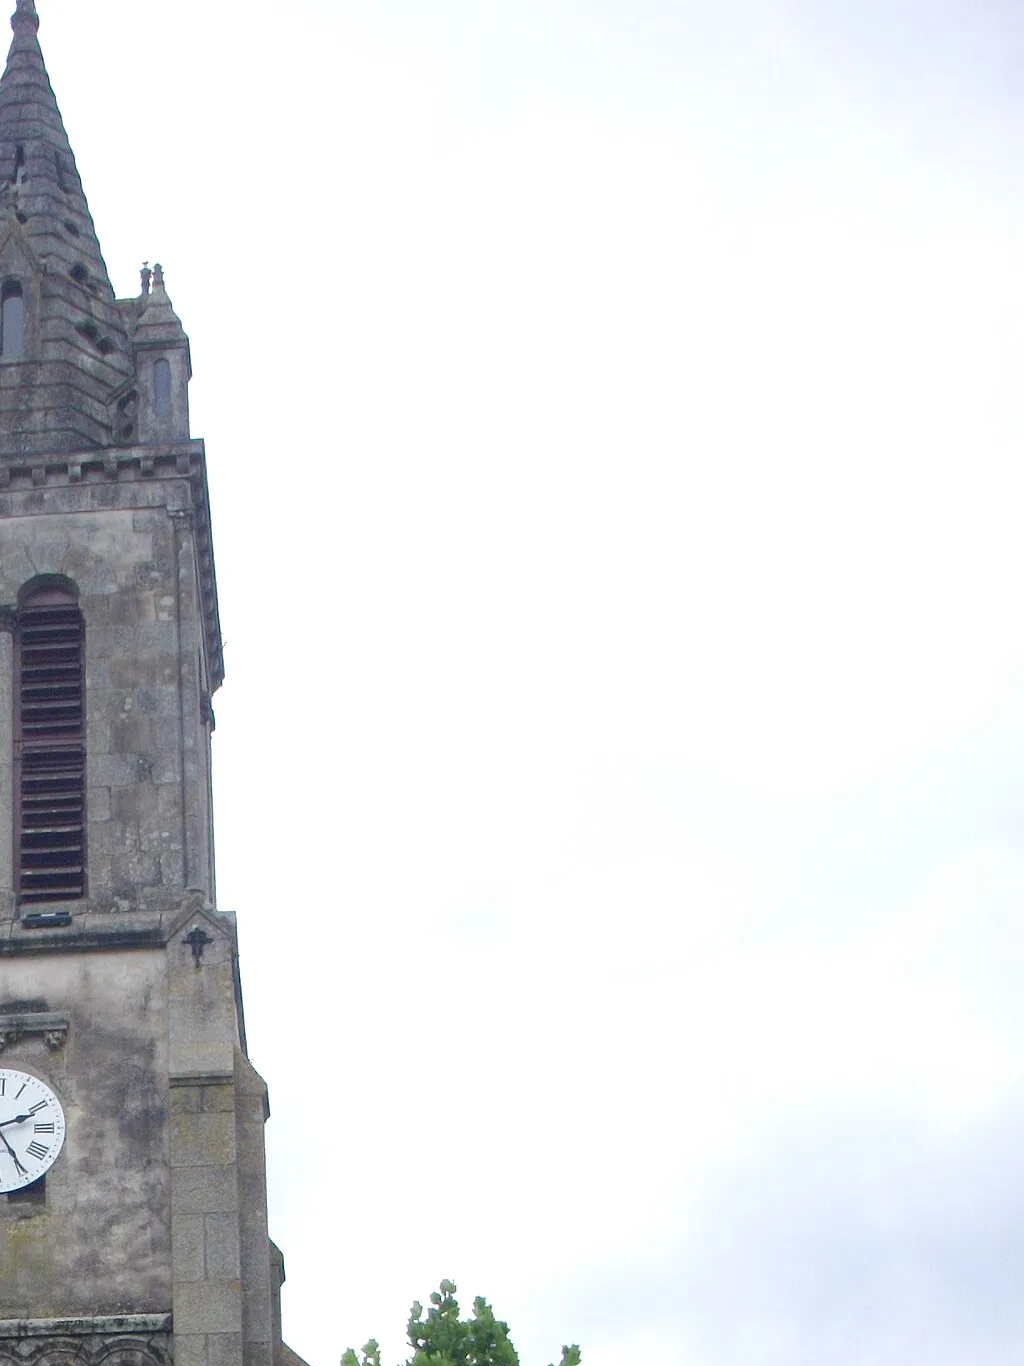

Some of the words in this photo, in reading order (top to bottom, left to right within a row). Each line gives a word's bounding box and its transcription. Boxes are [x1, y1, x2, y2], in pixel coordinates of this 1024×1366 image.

[14, 1083, 27, 1099] I
[29, 1100, 48, 1115] II
[34, 1122, 55, 1134] III
[25, 1140, 49, 1161] IIII
